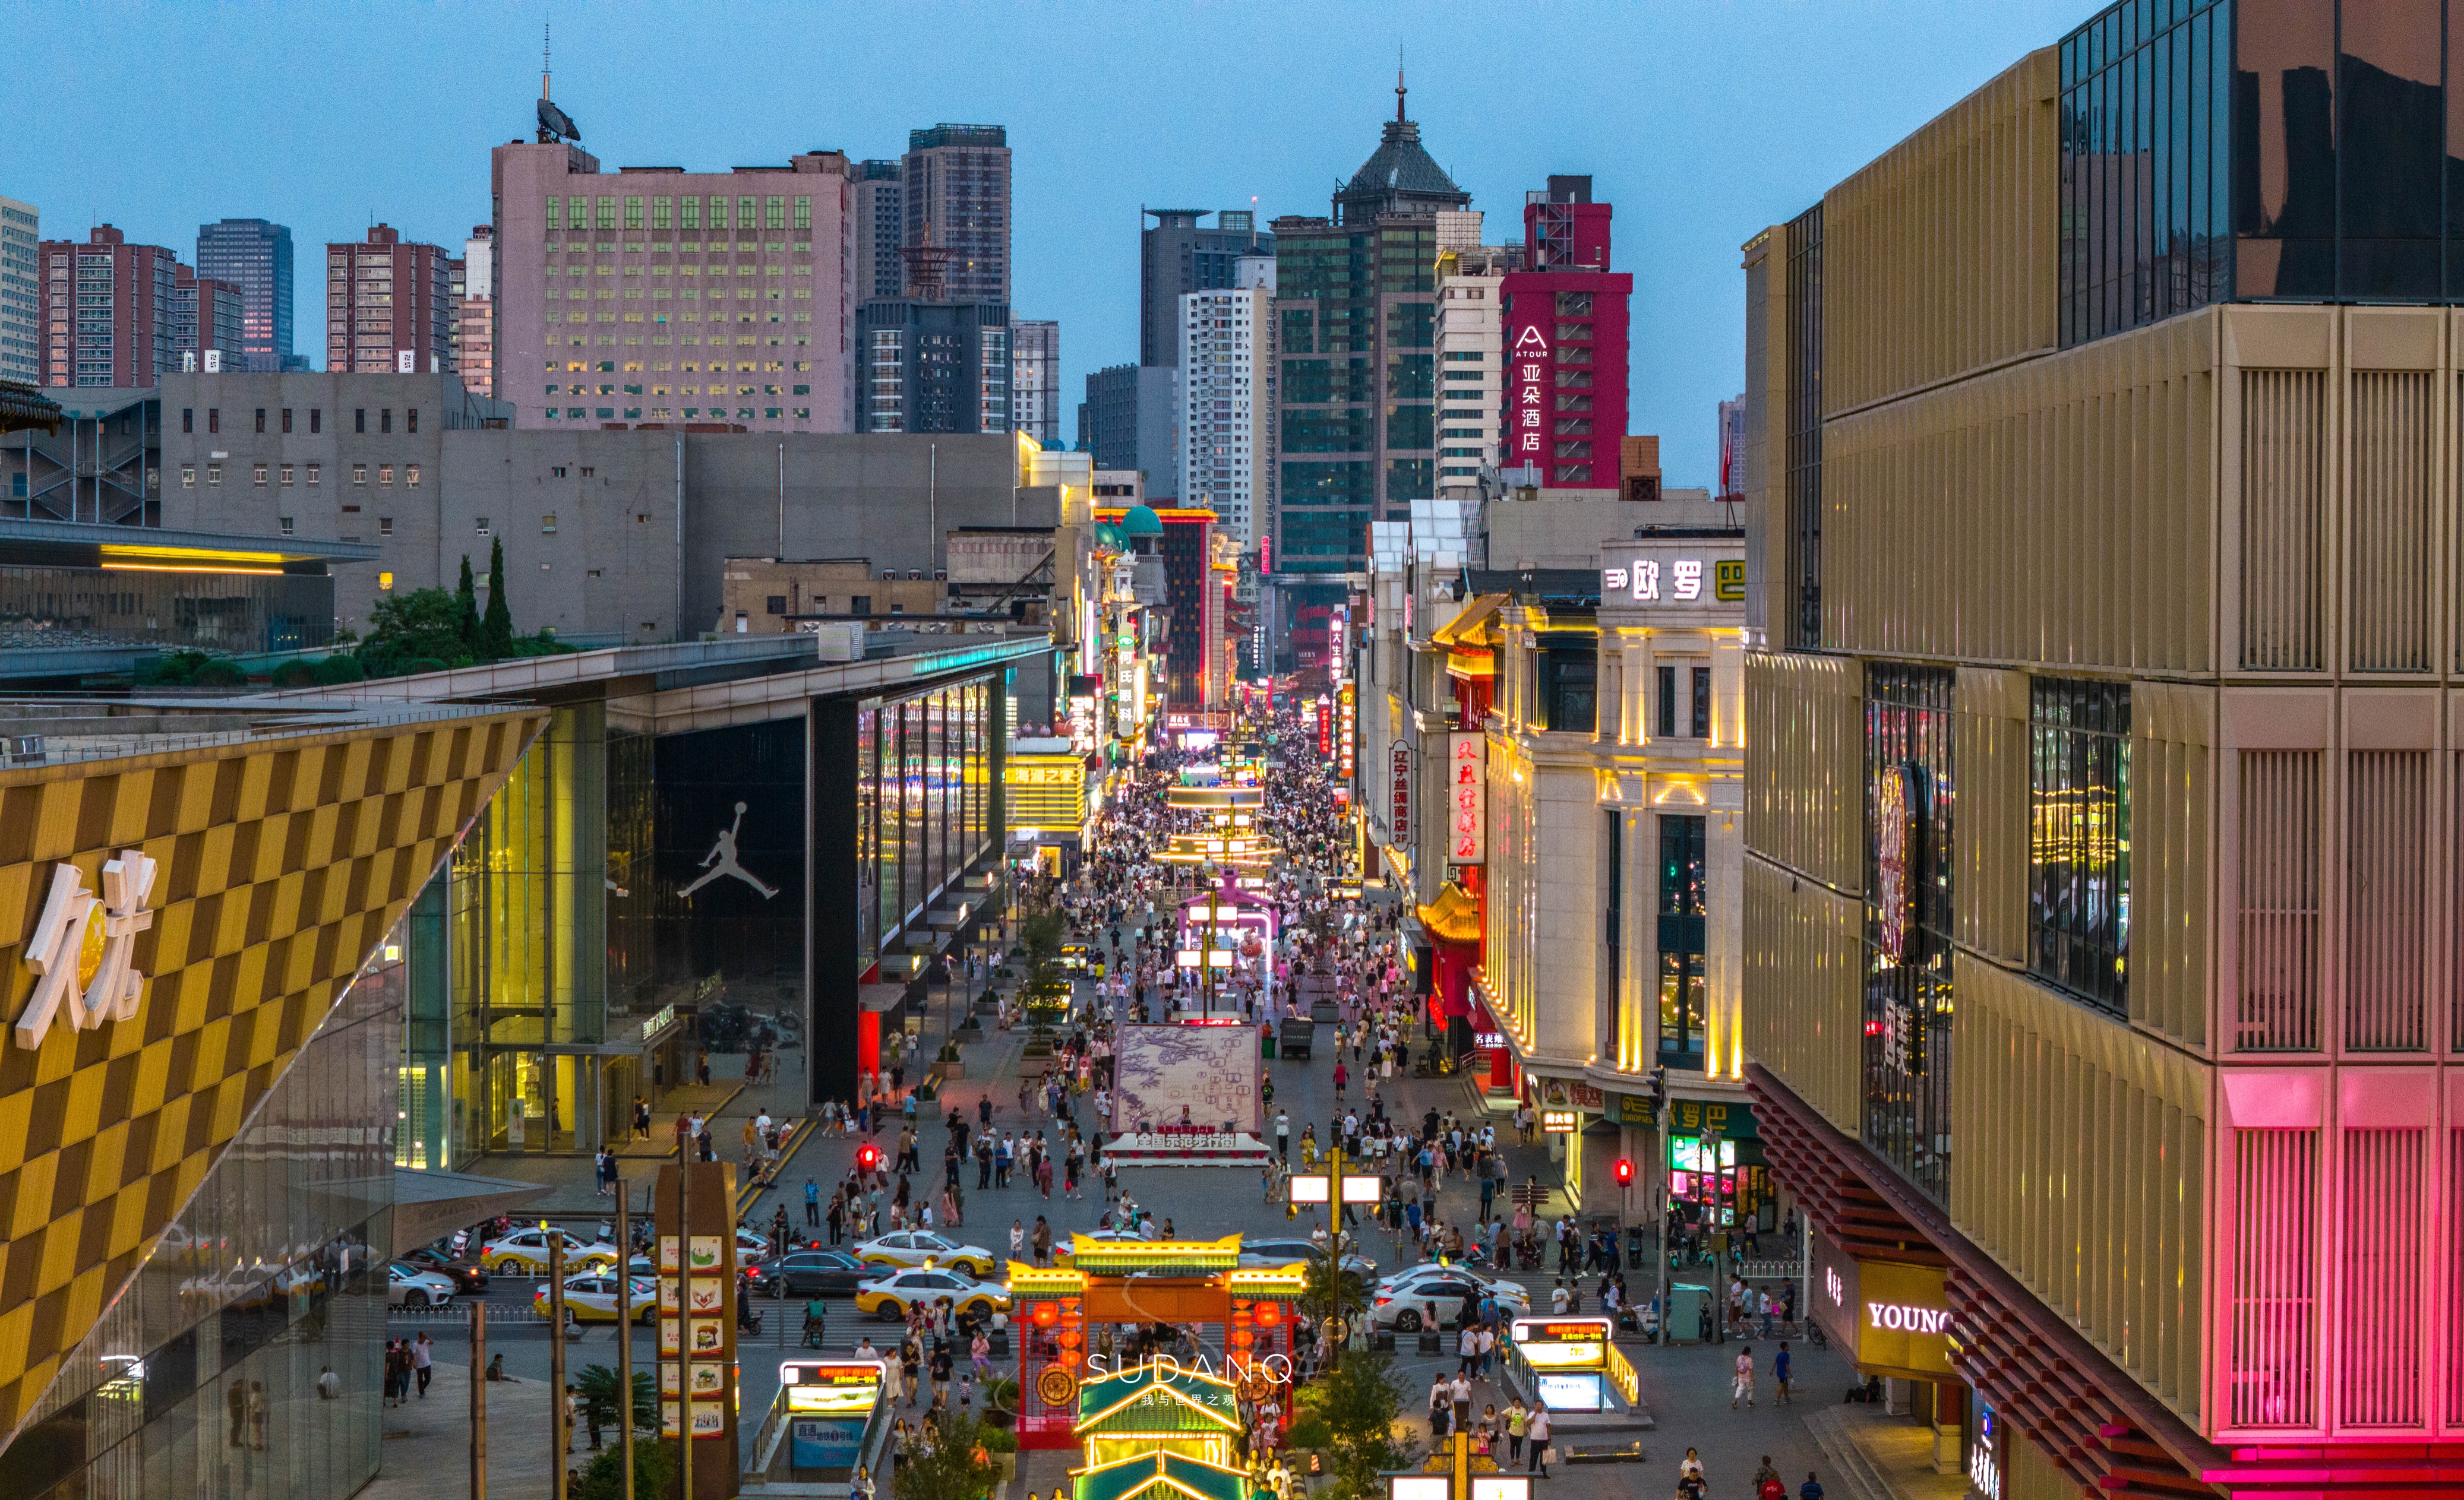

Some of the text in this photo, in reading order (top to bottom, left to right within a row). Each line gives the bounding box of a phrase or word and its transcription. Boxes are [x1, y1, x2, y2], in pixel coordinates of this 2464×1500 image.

[1522, 365, 1541, 451] 亚朵酒店
[1119, 651, 1133, 721] 何氏眼科
[1015, 768, 1074, 783] 海澜之家
[1394, 751, 1408, 843] 辽宁丝绸商店 2F
[1475, 1034, 1505, 1044] 名表维
[1136, 1132, 1236, 1148] 全国示范步行街
